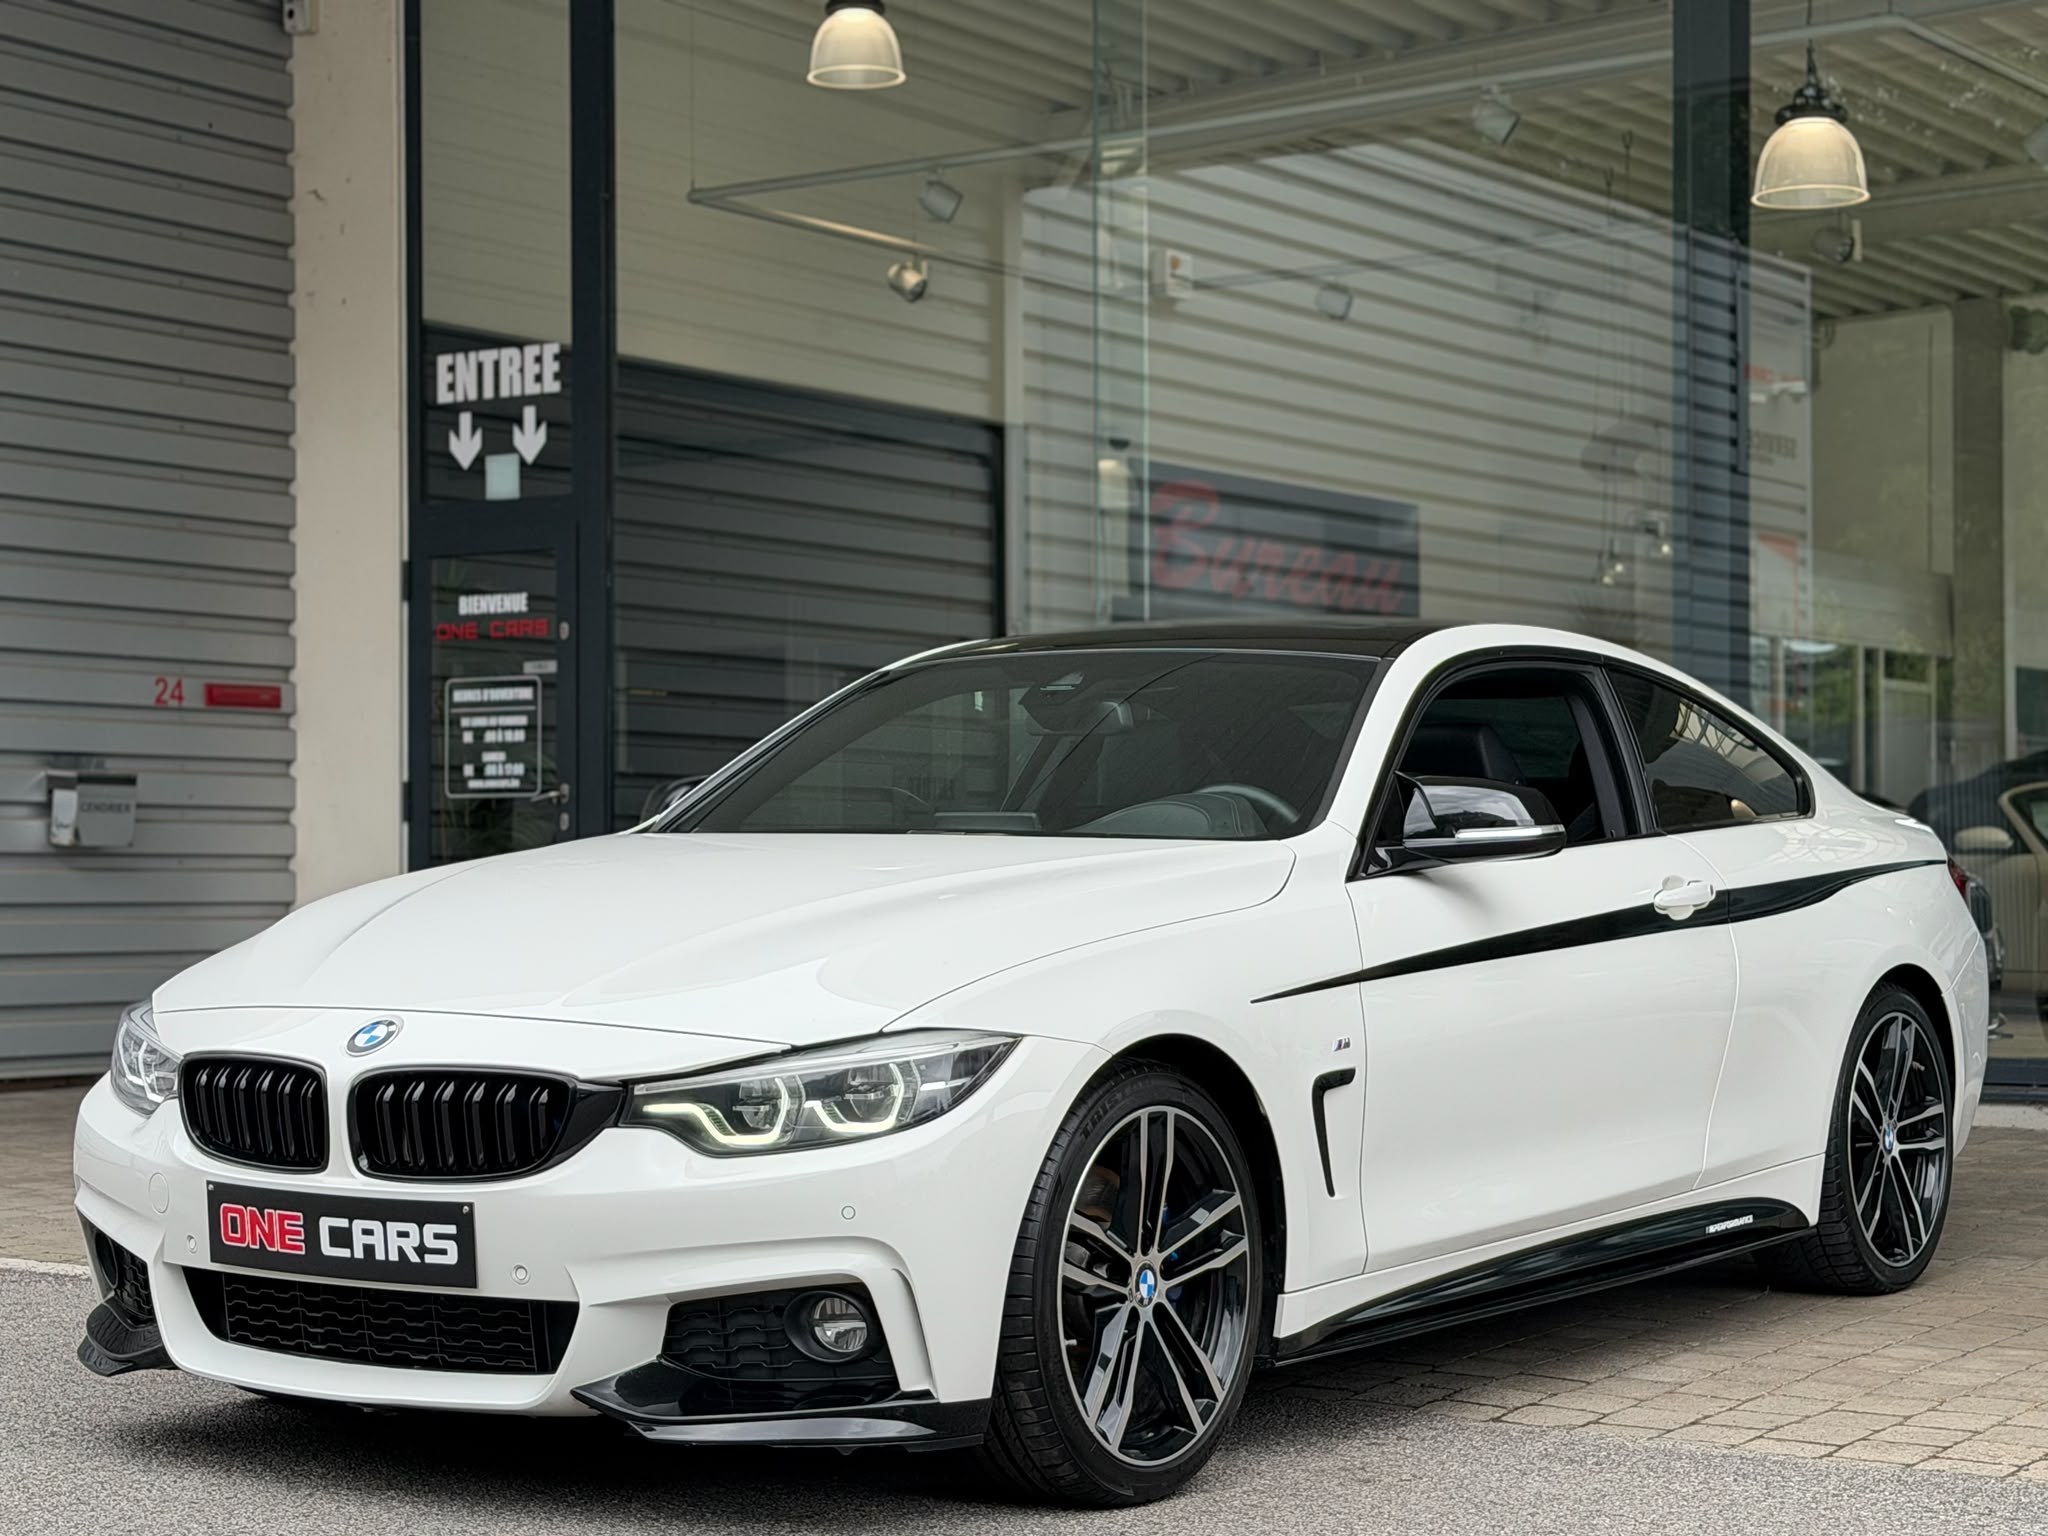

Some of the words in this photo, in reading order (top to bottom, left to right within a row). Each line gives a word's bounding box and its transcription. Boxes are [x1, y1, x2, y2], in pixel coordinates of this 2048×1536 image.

[436, 342, 562, 405] ENTREE
[458, 592, 529, 616] BIENVENUE
[436, 621, 478, 640] ONE
[489, 618, 549, 638] CARS
[154, 677, 184, 705] 24
[220, 1203, 306, 1255] ONE
[319, 1216, 458, 1265] CARS
